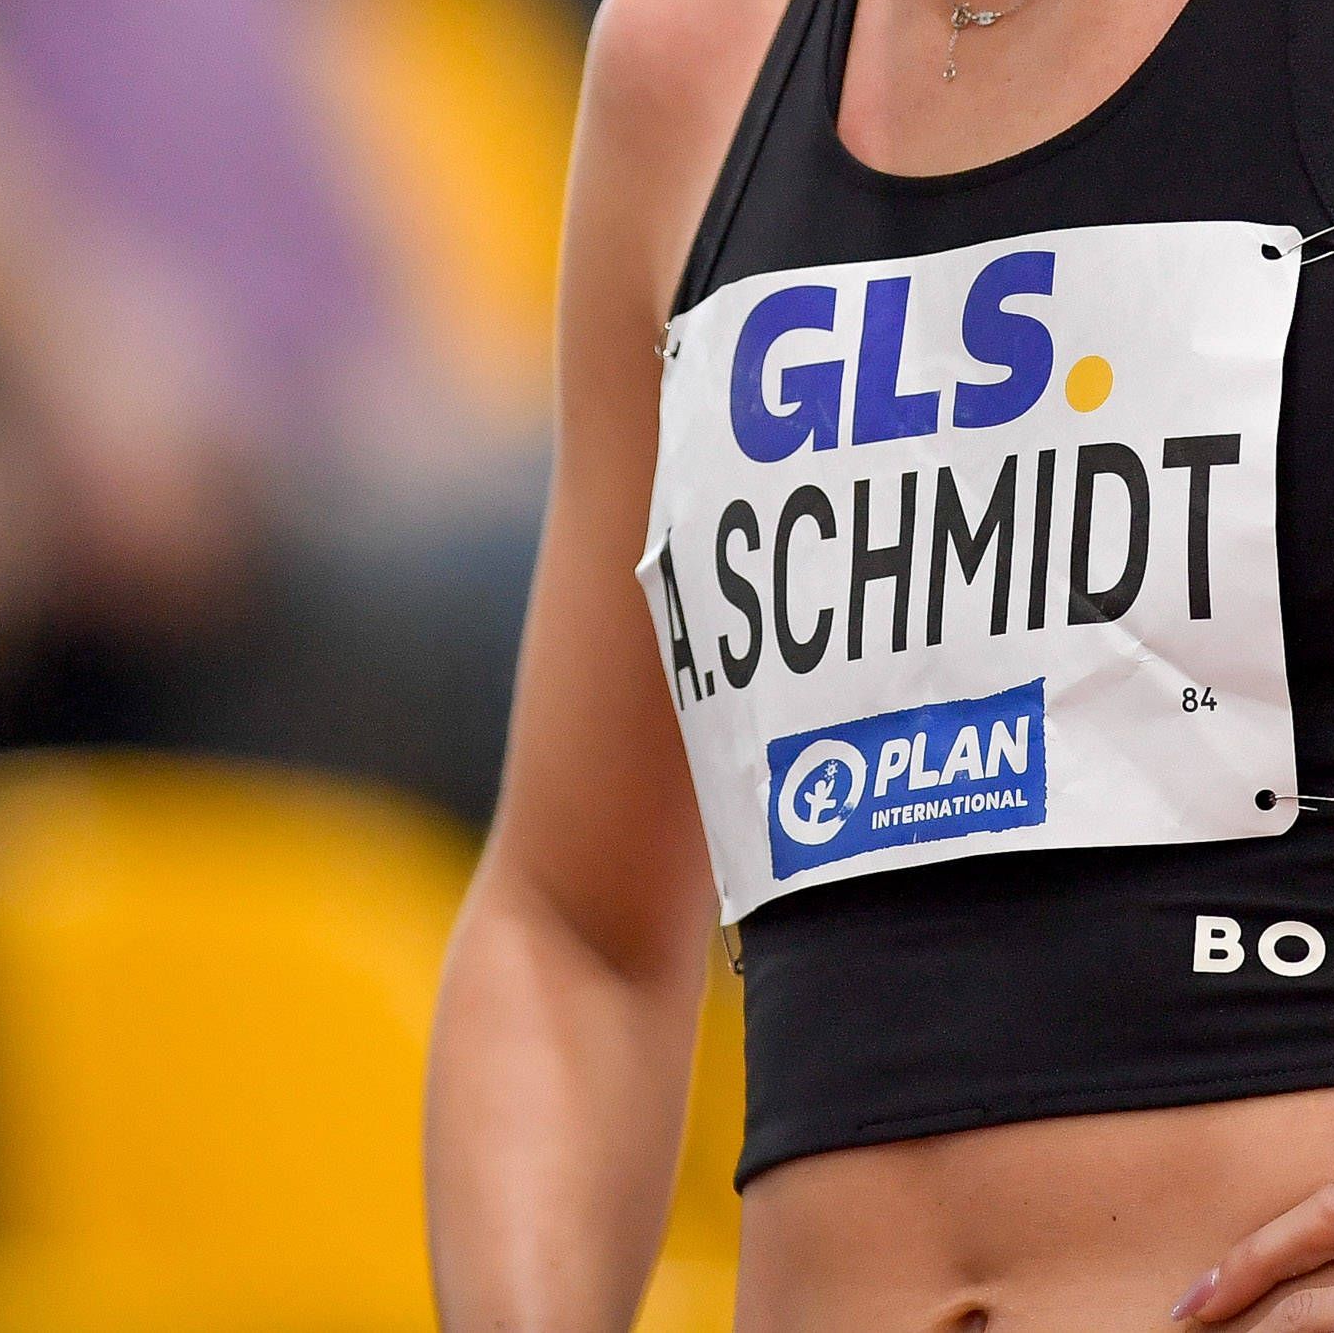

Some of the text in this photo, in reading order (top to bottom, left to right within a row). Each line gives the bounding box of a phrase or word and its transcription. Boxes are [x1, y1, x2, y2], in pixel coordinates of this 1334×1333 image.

[660, 433, 1241, 710] A.SCHMIDT
[1180, 687, 1218, 713] 84
[874, 715, 1030, 798] PLAN
[871, 790, 1028, 830] INTERNATIONAL
